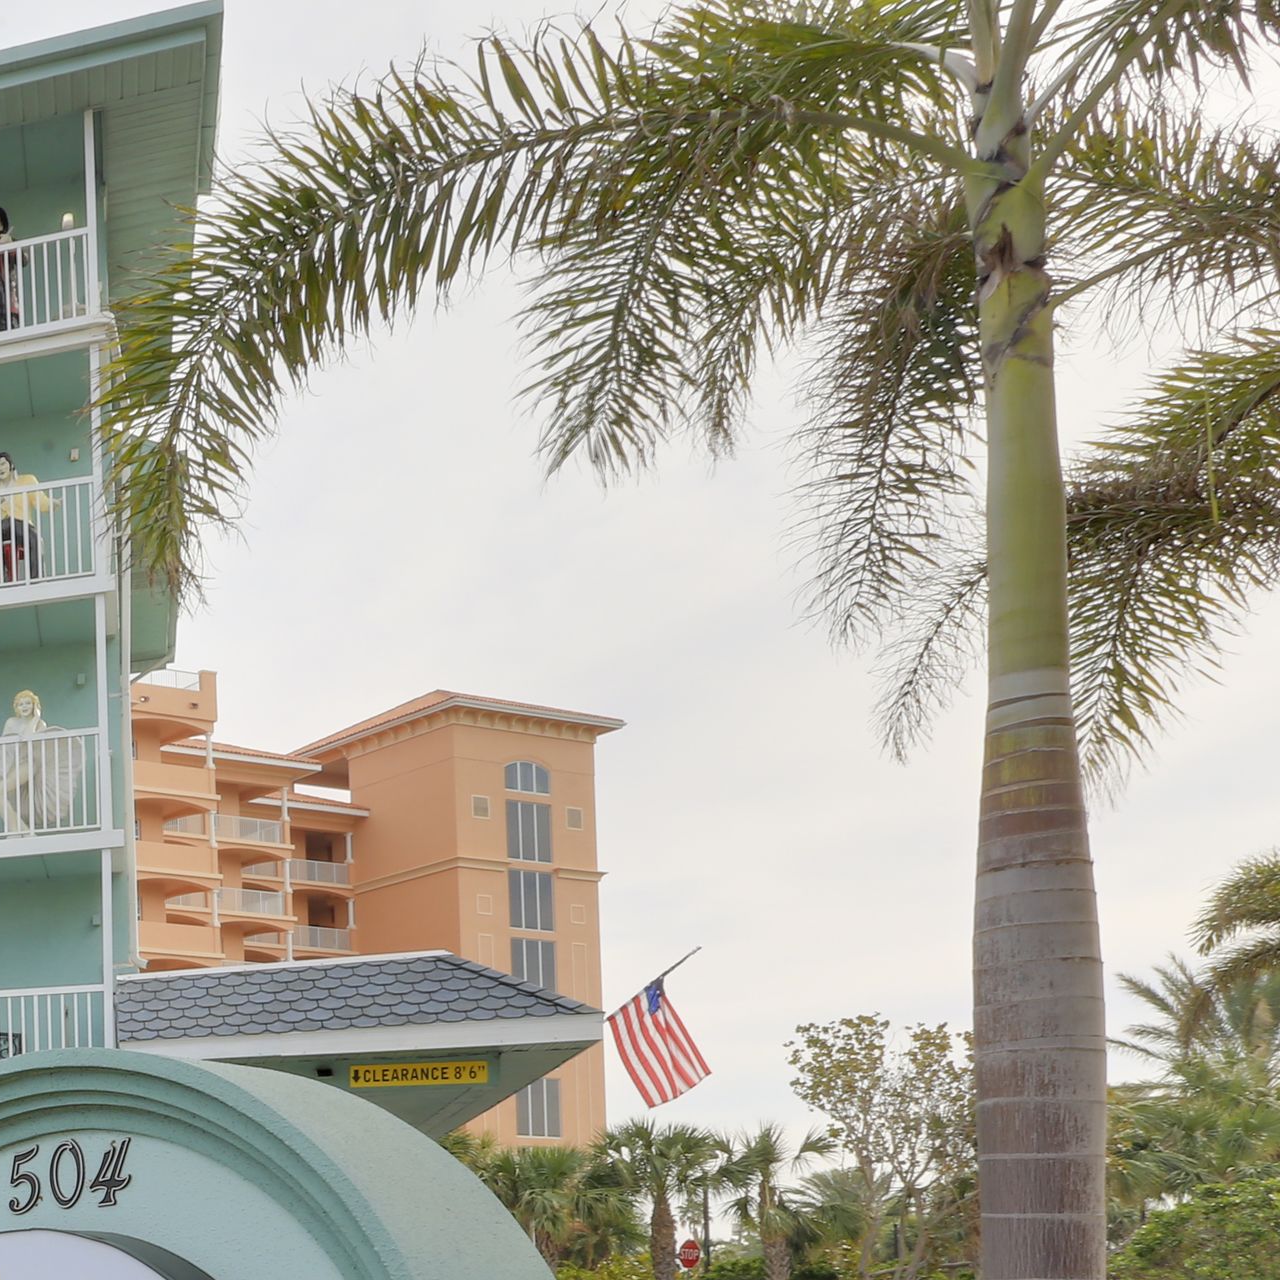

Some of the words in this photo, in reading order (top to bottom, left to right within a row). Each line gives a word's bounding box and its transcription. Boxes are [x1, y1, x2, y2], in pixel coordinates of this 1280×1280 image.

[363, 1067, 450, 1083] CLEARANCE
[454, 1065, 466, 1080] 8'
[8, 1137, 132, 1214] 504
[680, 1248, 699, 1261] STOP
